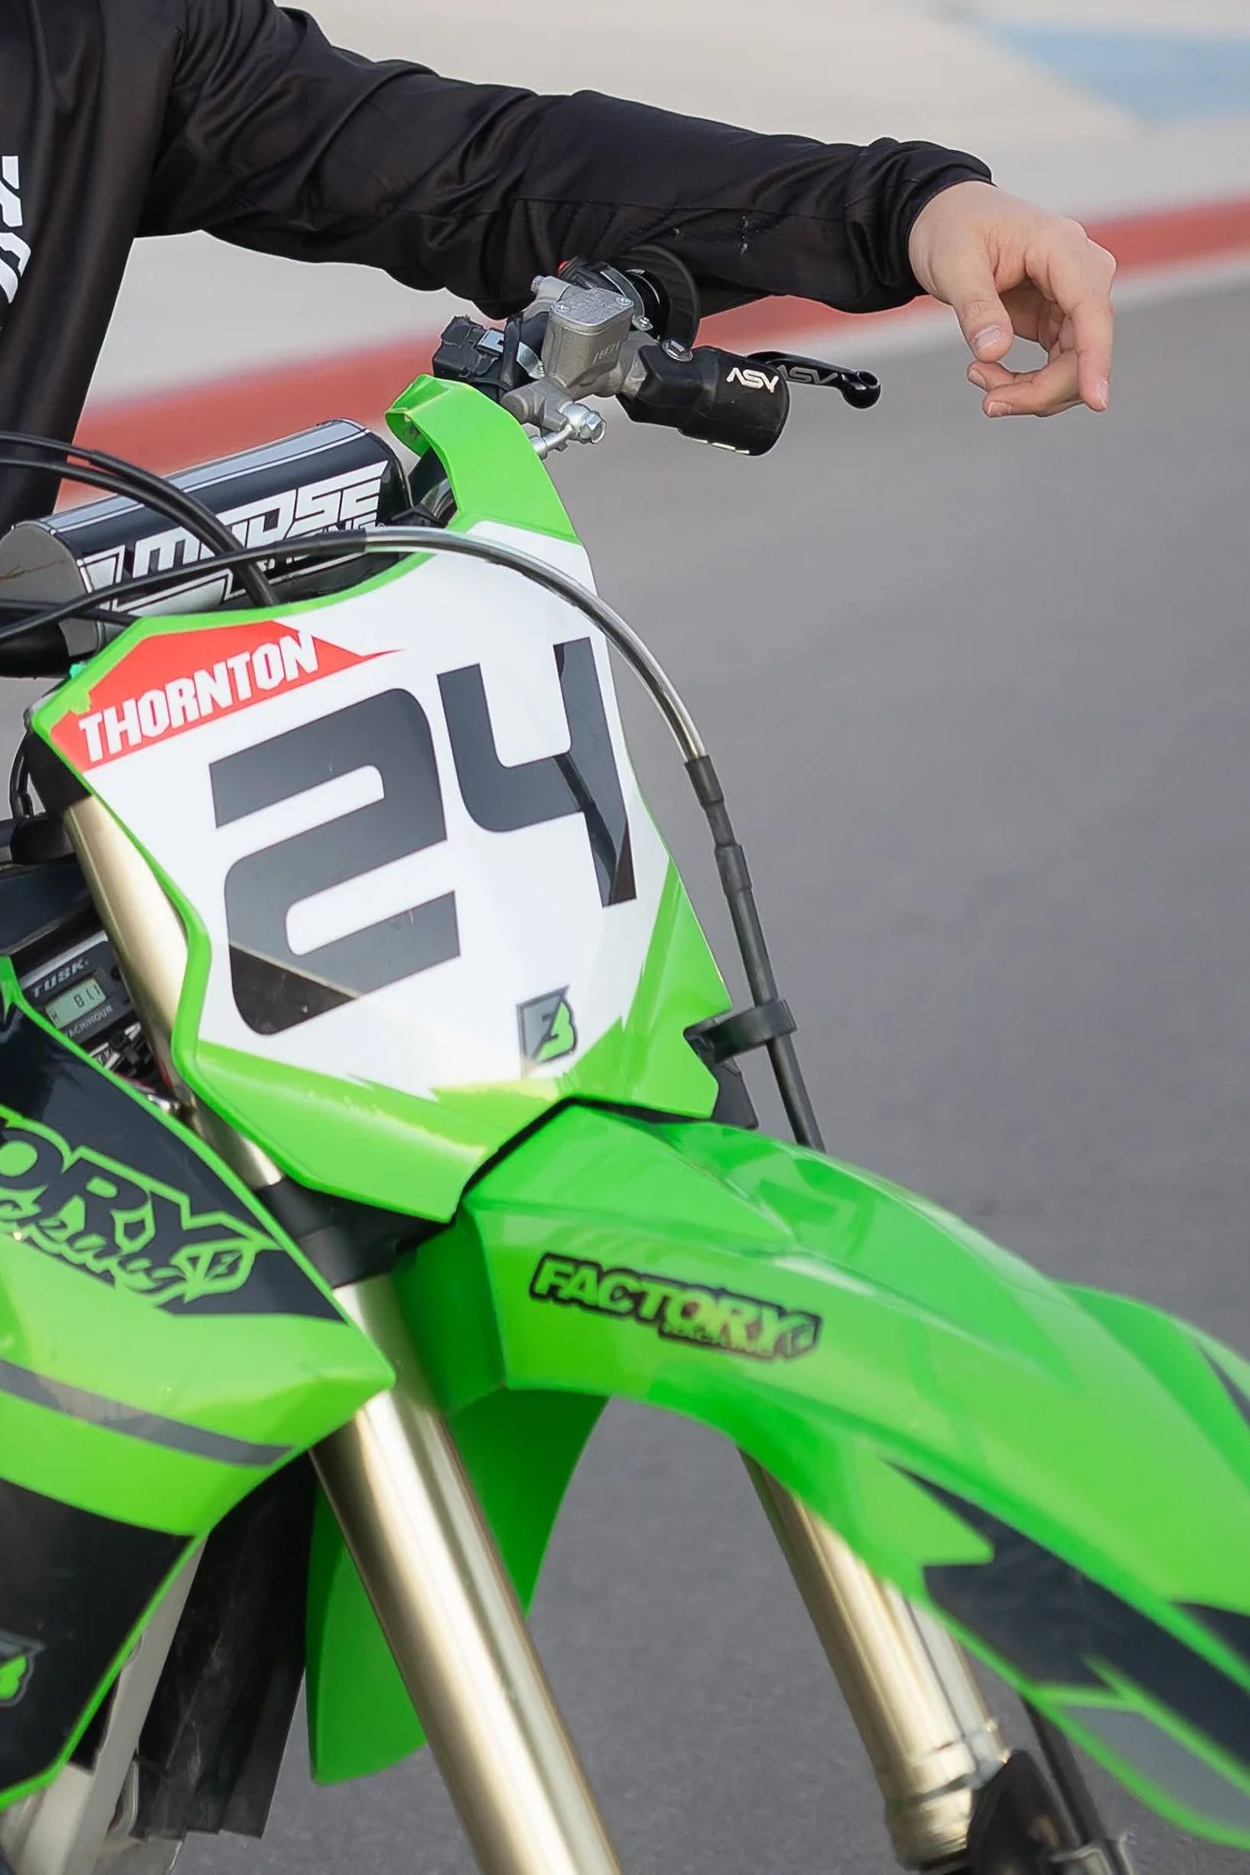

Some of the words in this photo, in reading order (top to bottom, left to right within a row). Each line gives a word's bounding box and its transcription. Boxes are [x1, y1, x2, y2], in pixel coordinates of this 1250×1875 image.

[726, 367, 779, 394] ASV
[78, 629, 319, 763] THORNTON
[208, 636, 637, 1035] 24
[33, 958, 85, 998] TUSK
[65, 1005, 114, 1038] ACH/HOUR
[530, 1253, 816, 1359] FACTORY
